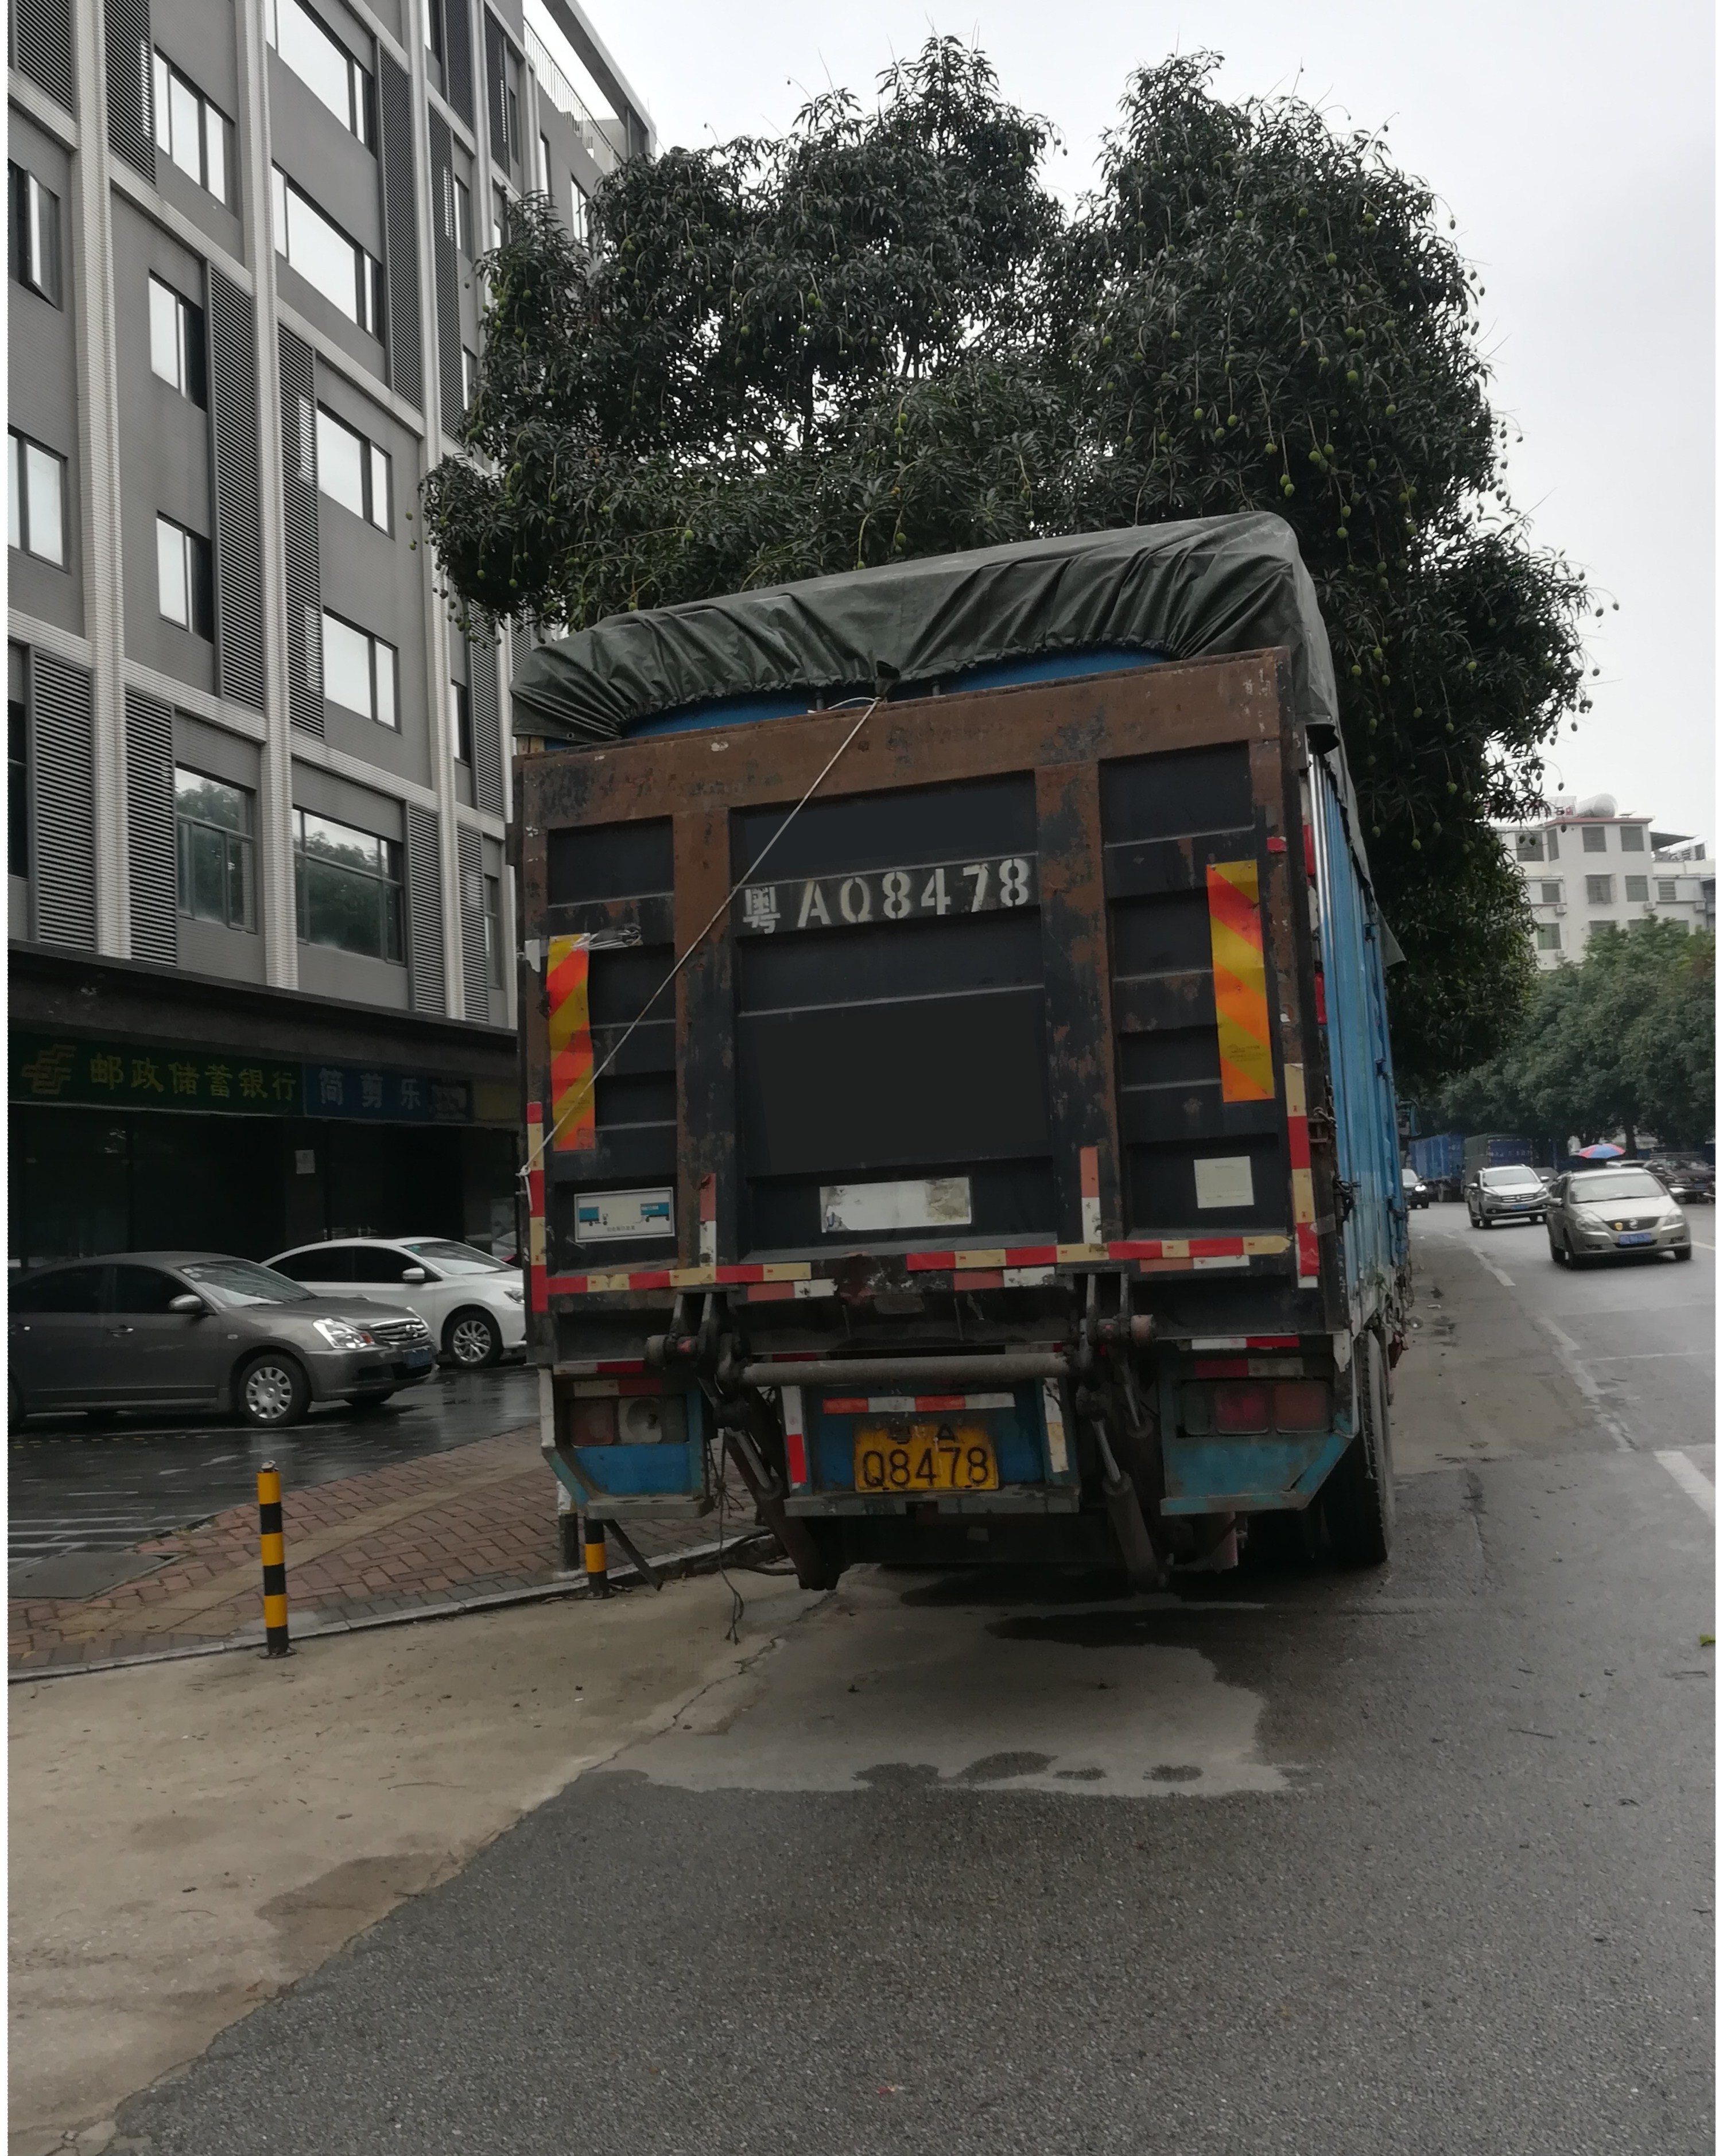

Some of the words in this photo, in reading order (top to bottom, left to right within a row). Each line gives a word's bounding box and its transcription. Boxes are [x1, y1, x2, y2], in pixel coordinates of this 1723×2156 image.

[90, 1052, 297, 1101] 邮政储蓄银行
[863, 1447, 988, 1487] Q8478
